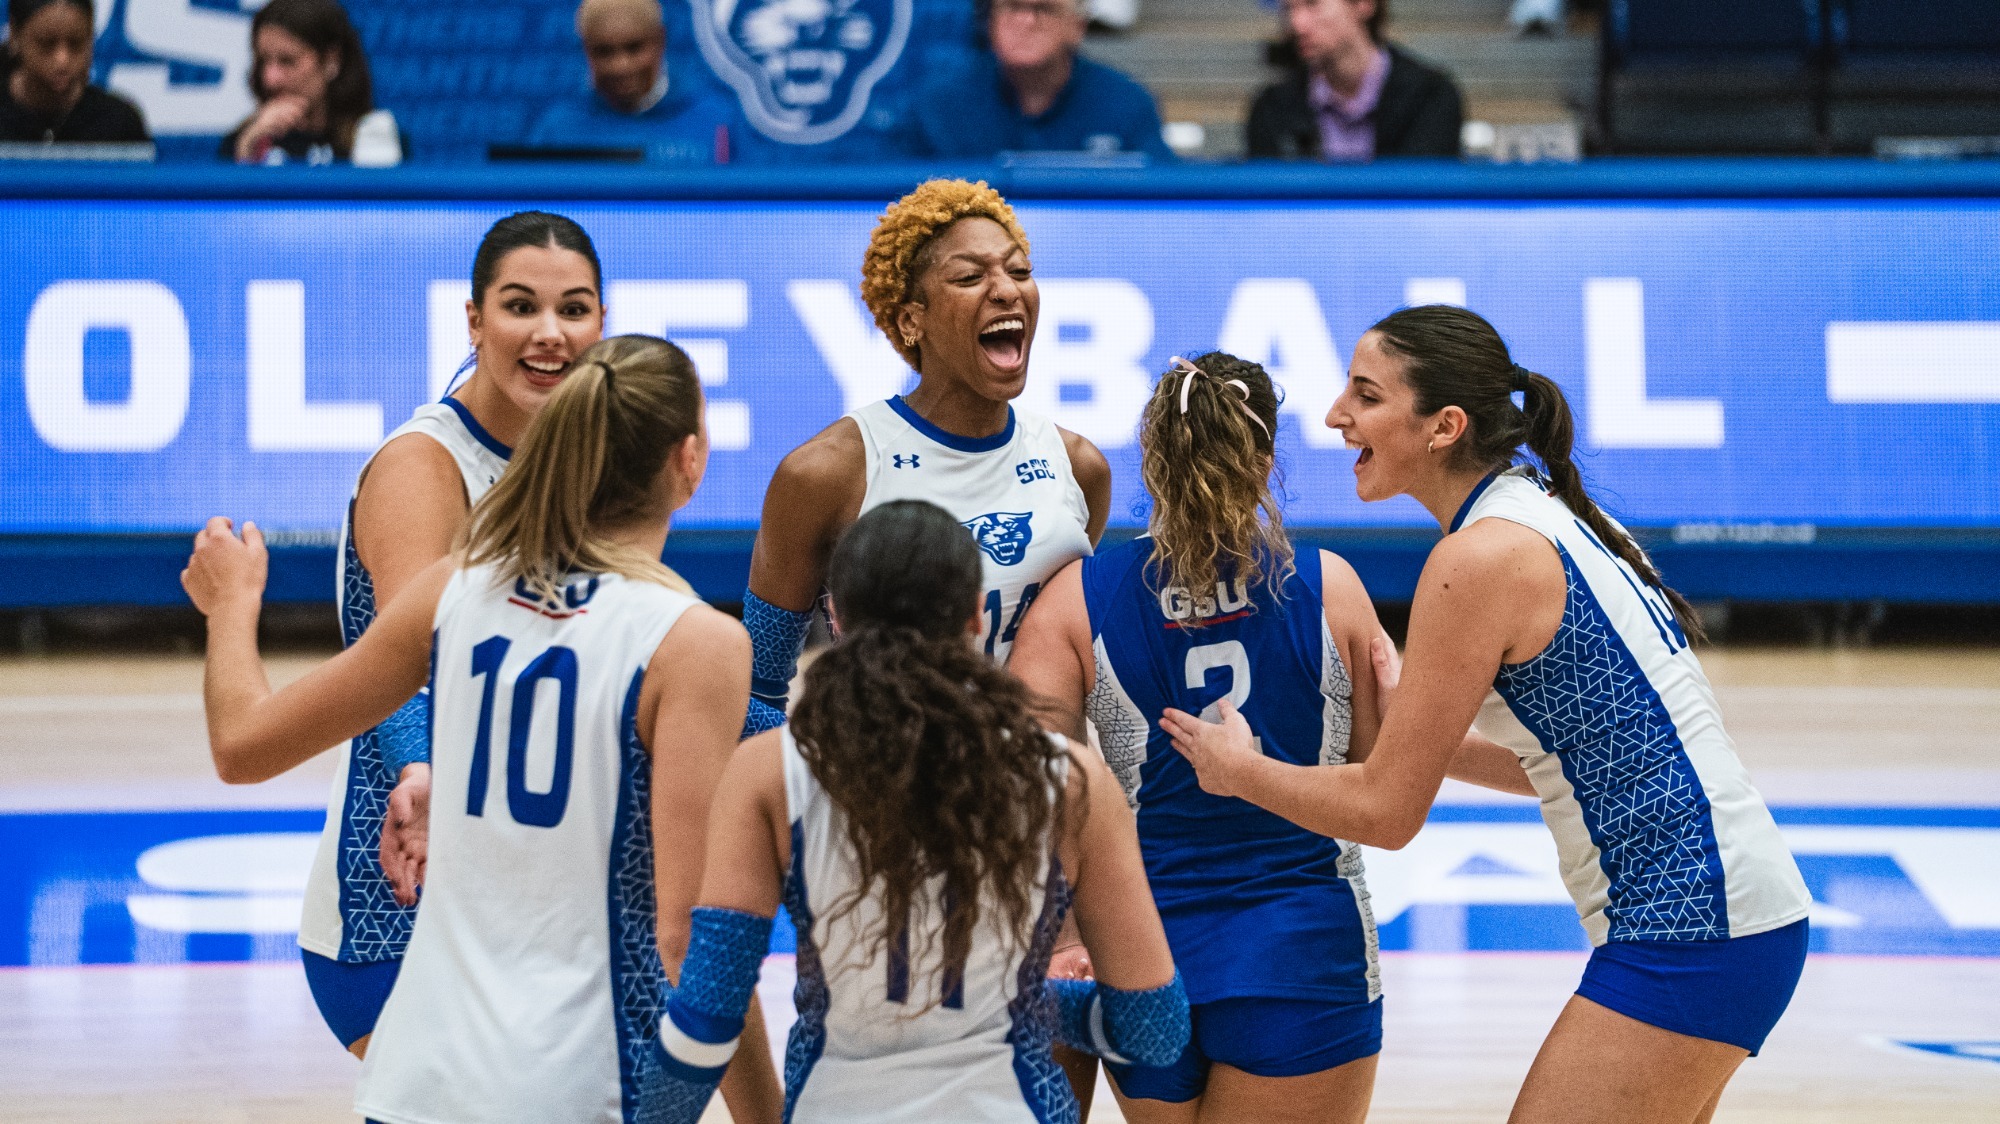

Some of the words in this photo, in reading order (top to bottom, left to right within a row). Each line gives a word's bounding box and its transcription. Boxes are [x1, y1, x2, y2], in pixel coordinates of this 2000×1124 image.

[24, 277, 1725, 453] OLEYBAL
[466, 634, 579, 828] 10
[1185, 639, 1263, 755] 2
